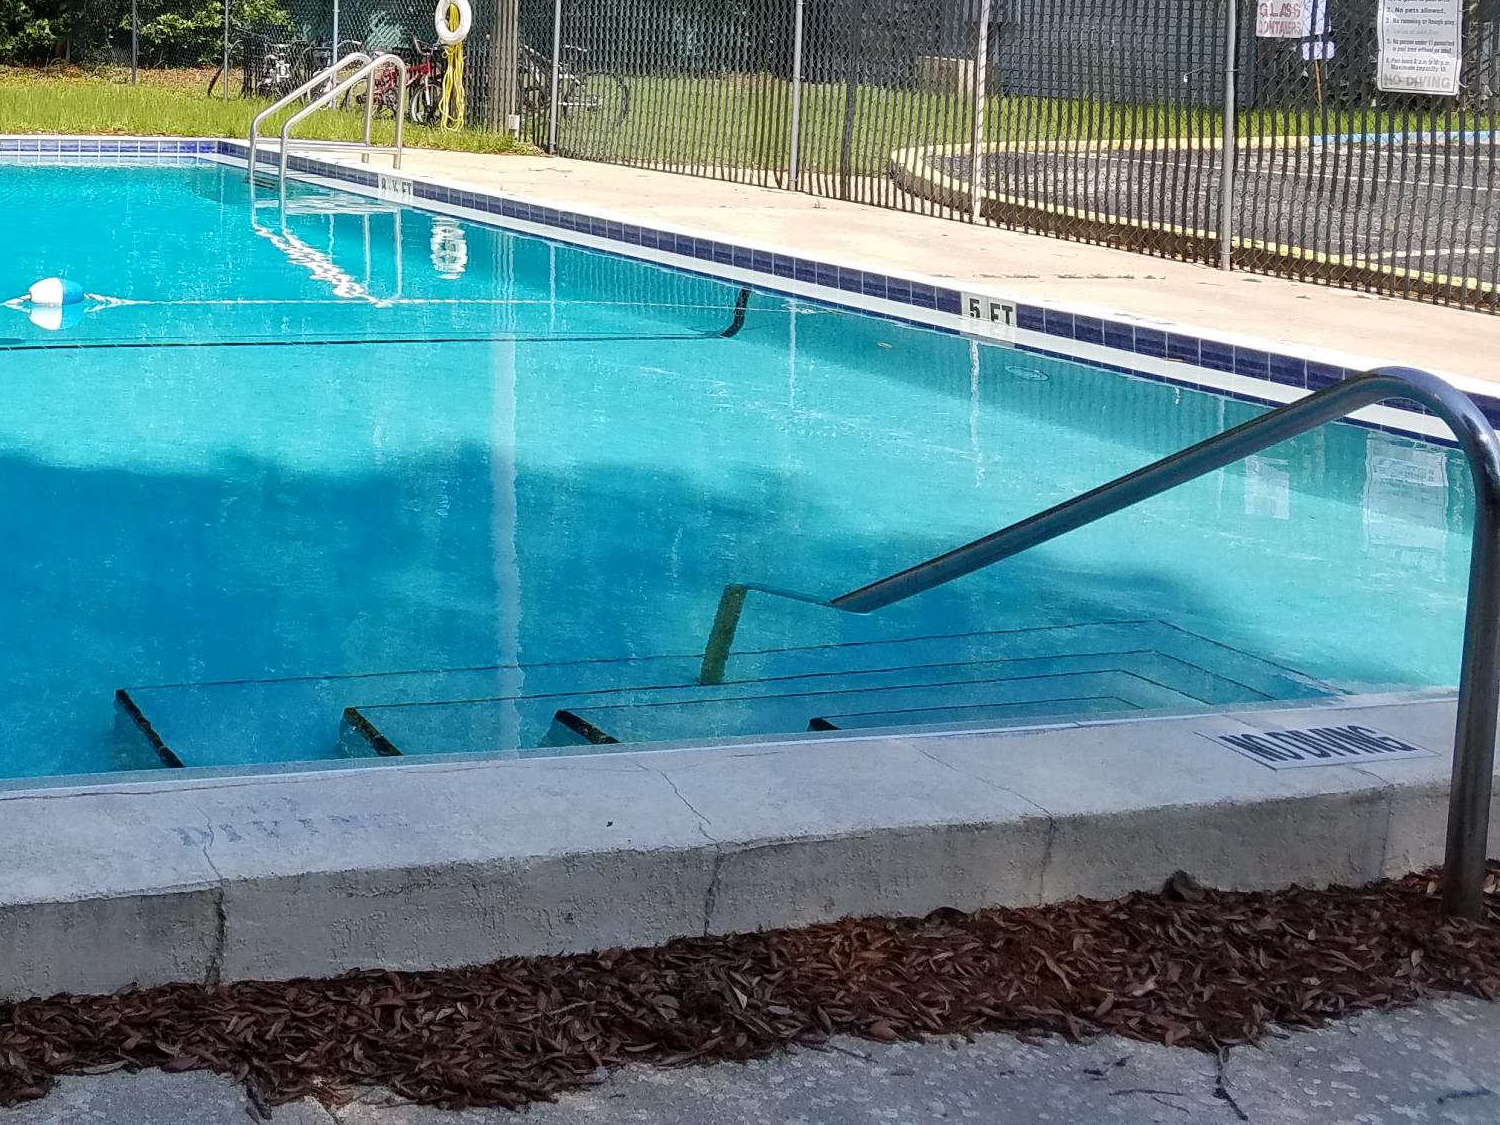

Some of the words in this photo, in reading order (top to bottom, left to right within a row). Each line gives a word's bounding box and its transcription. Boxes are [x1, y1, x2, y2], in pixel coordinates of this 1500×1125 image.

[1260, 3, 1300, 18] GLASS
[1384, 74, 1400, 86] NO
[1406, 75, 1451, 89] DIVING
[401, 181, 411, 195] FT
[969, 298, 981, 319] 5
[990, 302, 1013, 325] FT
[1218, 732, 1305, 763] NO
[1264, 725, 1419, 759] DIVING
